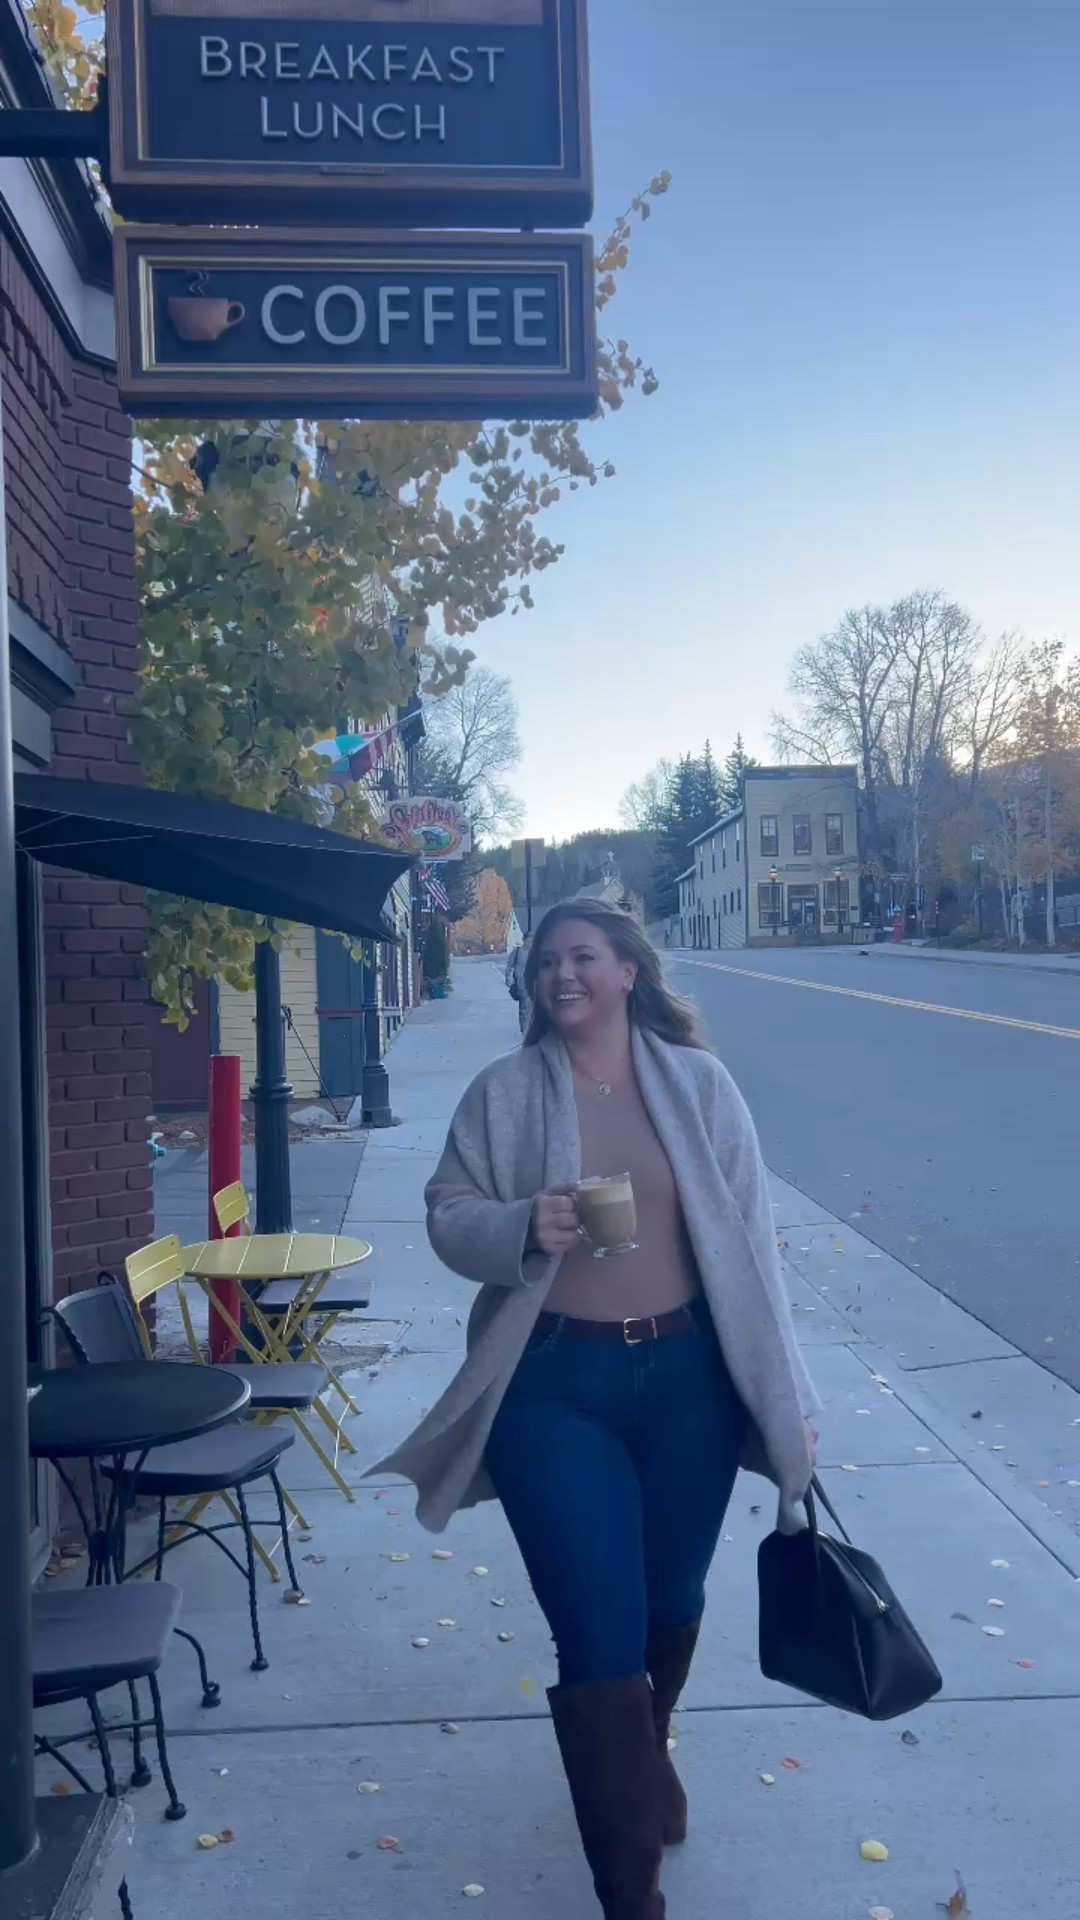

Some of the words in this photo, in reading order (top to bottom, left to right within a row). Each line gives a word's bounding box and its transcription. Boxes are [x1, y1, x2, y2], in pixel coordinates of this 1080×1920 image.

[199, 35, 506, 84] BREAKFAST
[260, 96, 447, 141] LUNCH
[260, 284, 548, 347] COFFEE
